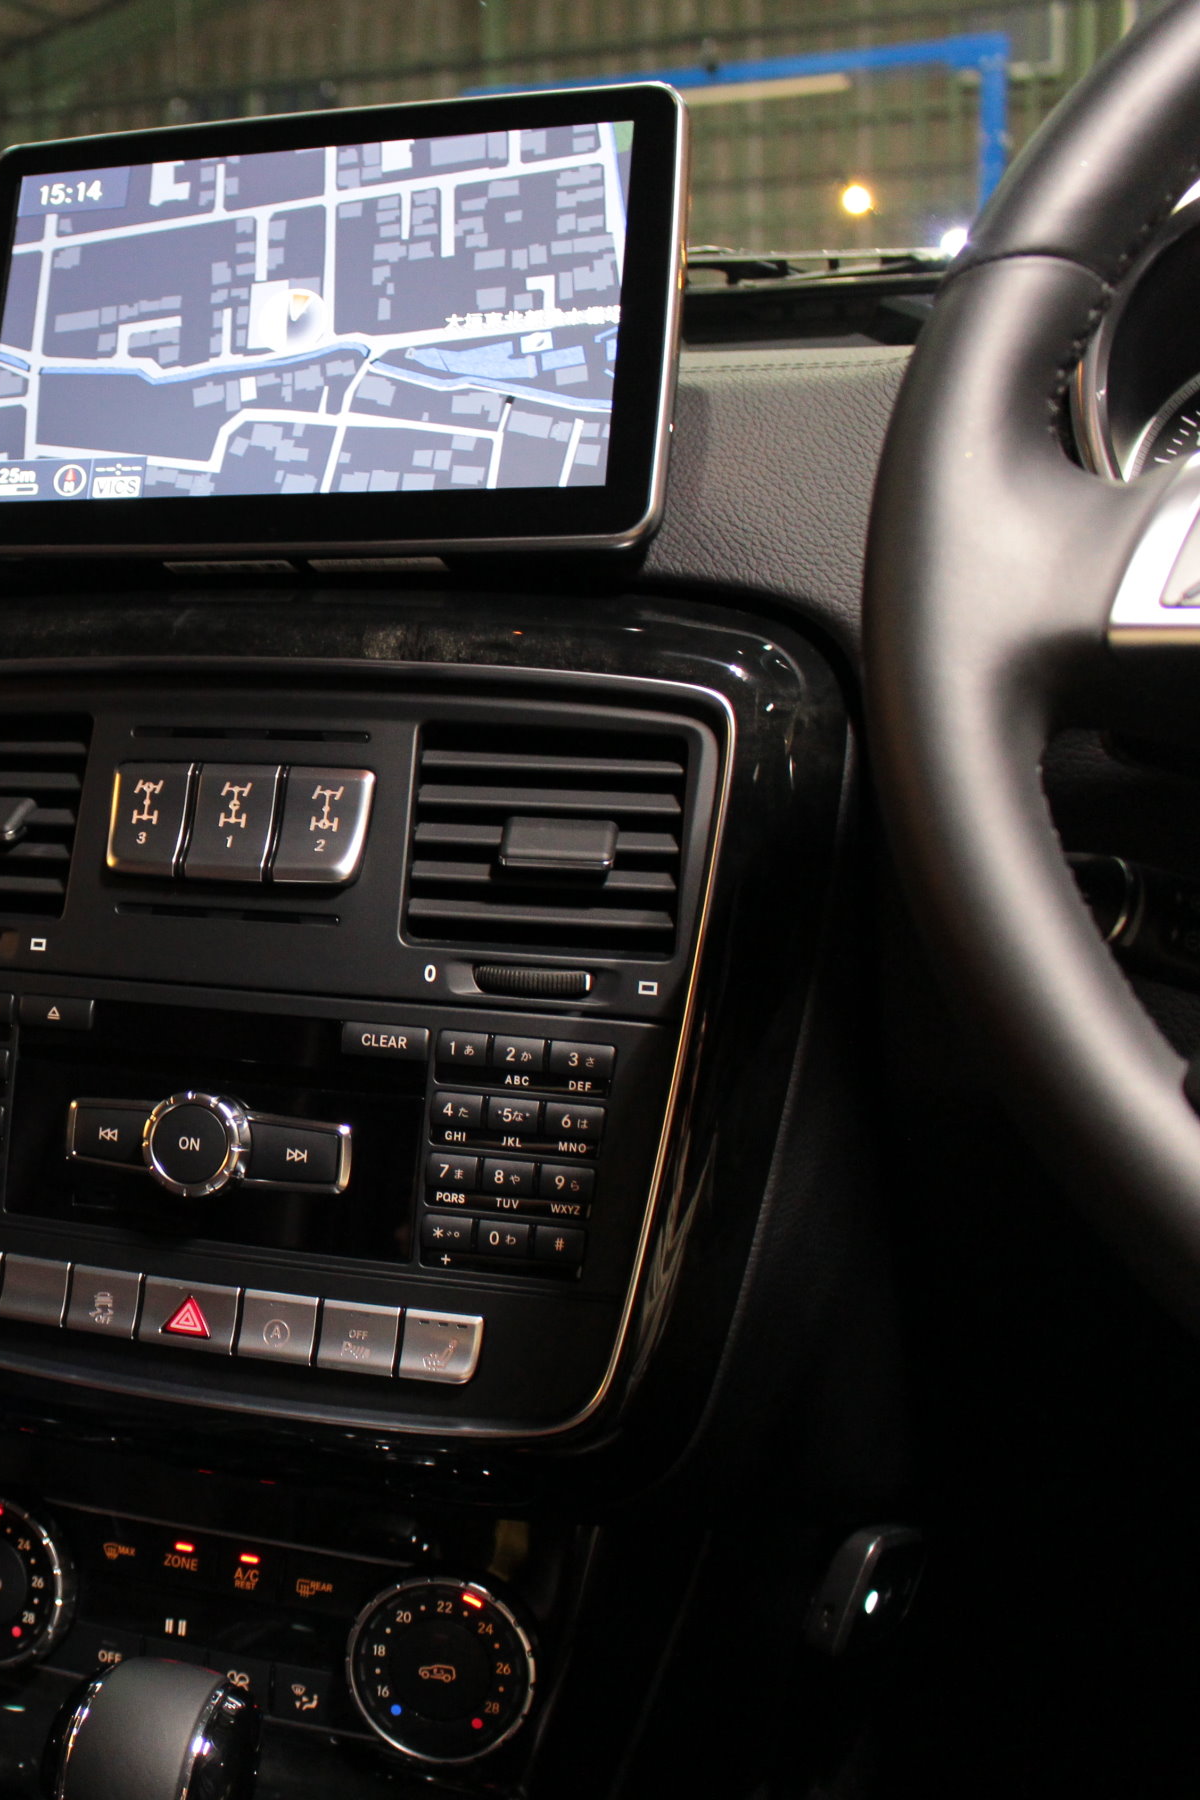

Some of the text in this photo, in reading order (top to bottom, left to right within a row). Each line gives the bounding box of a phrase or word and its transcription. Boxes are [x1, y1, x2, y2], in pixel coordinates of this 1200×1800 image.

[40, 180, 103, 206] 15:14
[94, 478, 138, 495] VICS
[136, 831, 147, 844] 3
[226, 835, 234, 848] 1
[314, 839, 325, 852] 2
[423, 964, 437, 983] 0
[361, 1033, 408, 1049] CLEAR
[504, 1074, 530, 1086] ABC
[568, 1080, 592, 1092] DEF
[444, 1130, 466, 1142] GHI
[501, 1136, 522, 1148] JKL
[178, 1136, 200, 1151] ON
[558, 1141, 587, 1153] MNO
[436, 1191, 465, 1204] PQRS
[496, 1197, 519, 1210] TUV
[550, 1203, 581, 1216] WXYZ
[348, 1329, 369, 1341] OFF
[17, 1538, 31, 1551] 24
[118, 1545, 136, 1557] MAX
[163, 1554, 199, 1571] ZONE
[234, 1567, 260, 1582] A/C
[31, 1577, 44, 1589] 26
[234, 1581, 256, 1590] REST
[310, 1581, 333, 1592] REAR
[437, 1601, 453, 1613] 22
[22, 1611, 35, 1624] 28
[395, 1611, 412, 1623] 20
[477, 1622, 494, 1635] 24
[98, 1650, 122, 1663] OFF
[373, 1644, 386, 1657] 18
[496, 1662, 511, 1675] 26
[377, 1685, 390, 1697] 16
[484, 1702, 500, 1714] 28
